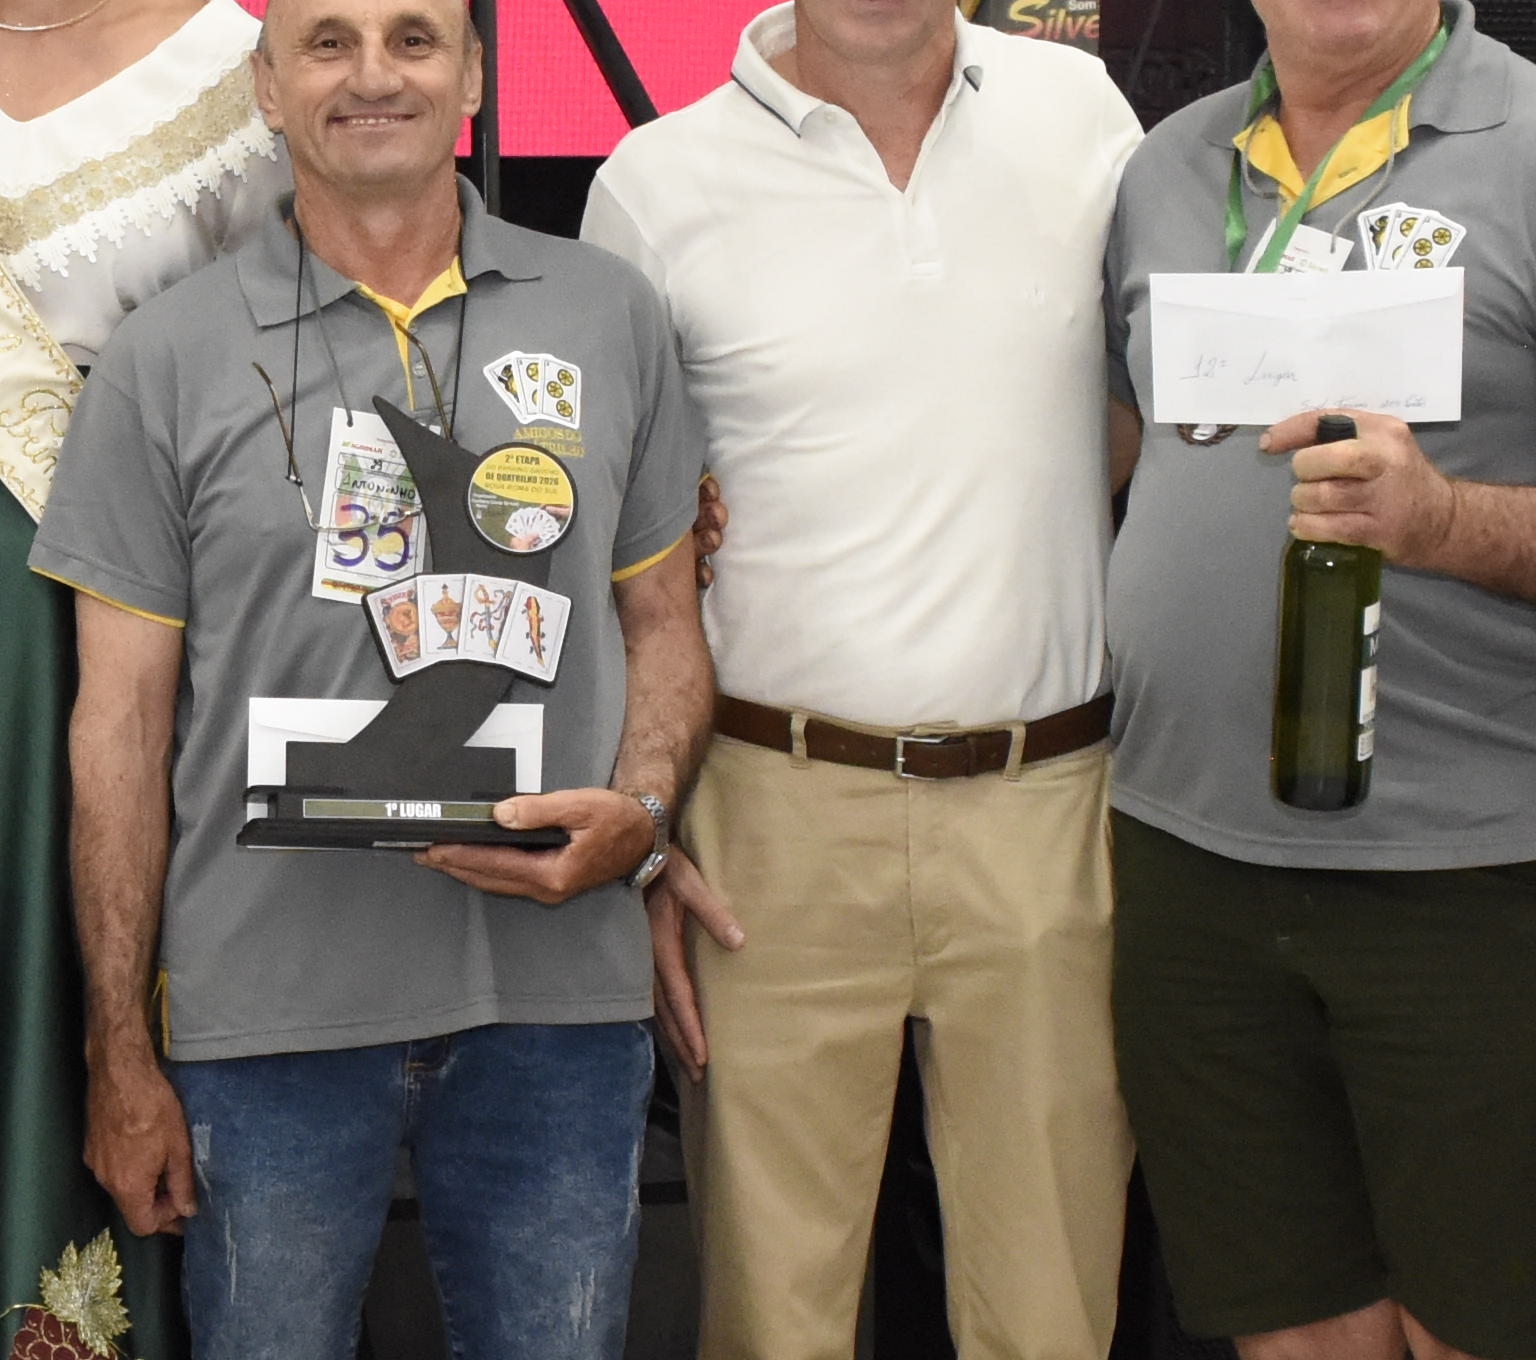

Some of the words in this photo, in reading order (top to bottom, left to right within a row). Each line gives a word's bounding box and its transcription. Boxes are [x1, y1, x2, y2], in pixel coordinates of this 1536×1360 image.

[1068, 0, 1096, 11] Som
[516, 455, 540, 465] ETAPA
[497, 473, 537, 484] QUATRILHO
[385, 803, 397, 817] 1º
[400, 803, 442, 818] LUGAR
